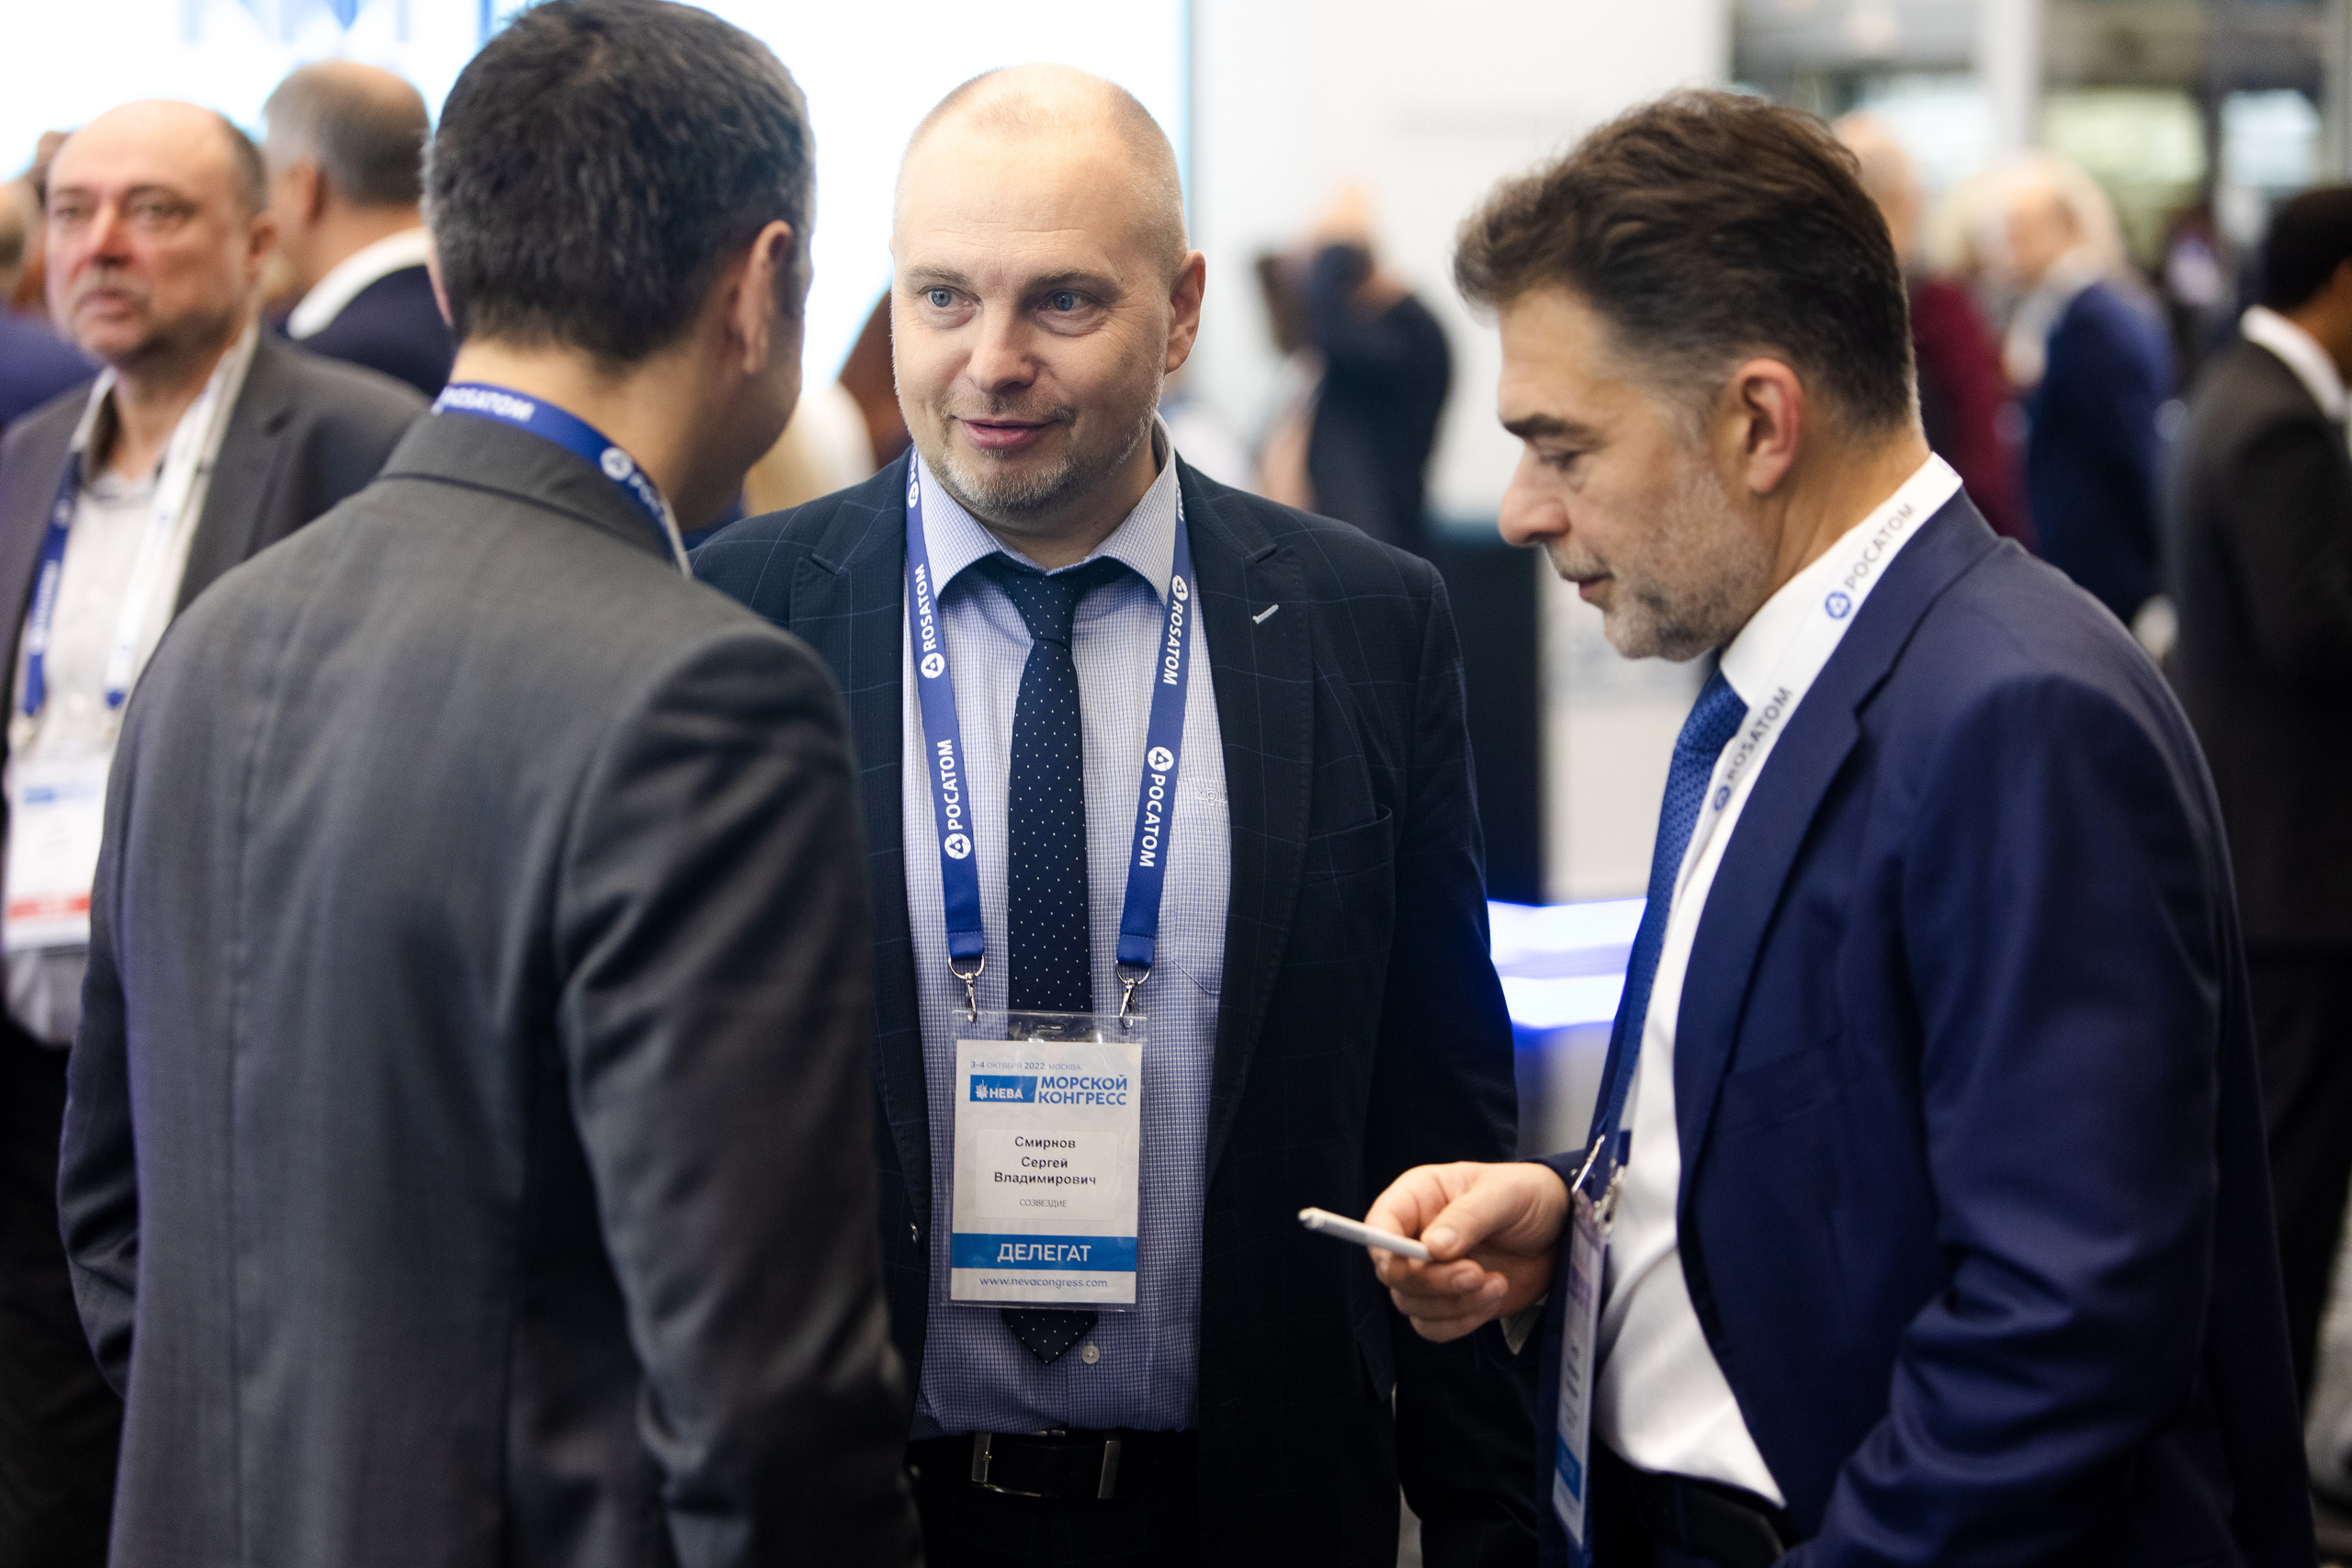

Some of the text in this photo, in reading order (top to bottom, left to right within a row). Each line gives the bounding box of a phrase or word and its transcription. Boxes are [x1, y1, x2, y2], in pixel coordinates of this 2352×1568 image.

[1844, 503, 1917, 592] РОСАТОМ
[914, 563, 937, 652] ROSATOM
[1163, 600, 1185, 685] ROSATOM
[937, 739, 963, 830] РОСАТОМ
[1139, 773, 1166, 867] РОСАТОМ
[970, 1060, 985, 1069] 3-4
[986, 1061, 1023, 1069] ОКТЯБРЯ
[1041, 1074, 1127, 1091] МОРСКОЙ
[989, 1088, 1023, 1100] НЕВА
[1038, 1091, 1126, 1105] КОНГРЕСС
[1014, 1136, 1076, 1150] Смирнов
[1021, 1156, 1069, 1169] Сергей
[994, 1171, 1096, 1186] Владимирович
[1019, 1198, 1068, 1208] СОЗВЕЗДИЕ
[997, 1243, 1091, 1263] ДЕЛЕГАТ
[979, 1275, 1108, 1289] www.nevacongress.com
